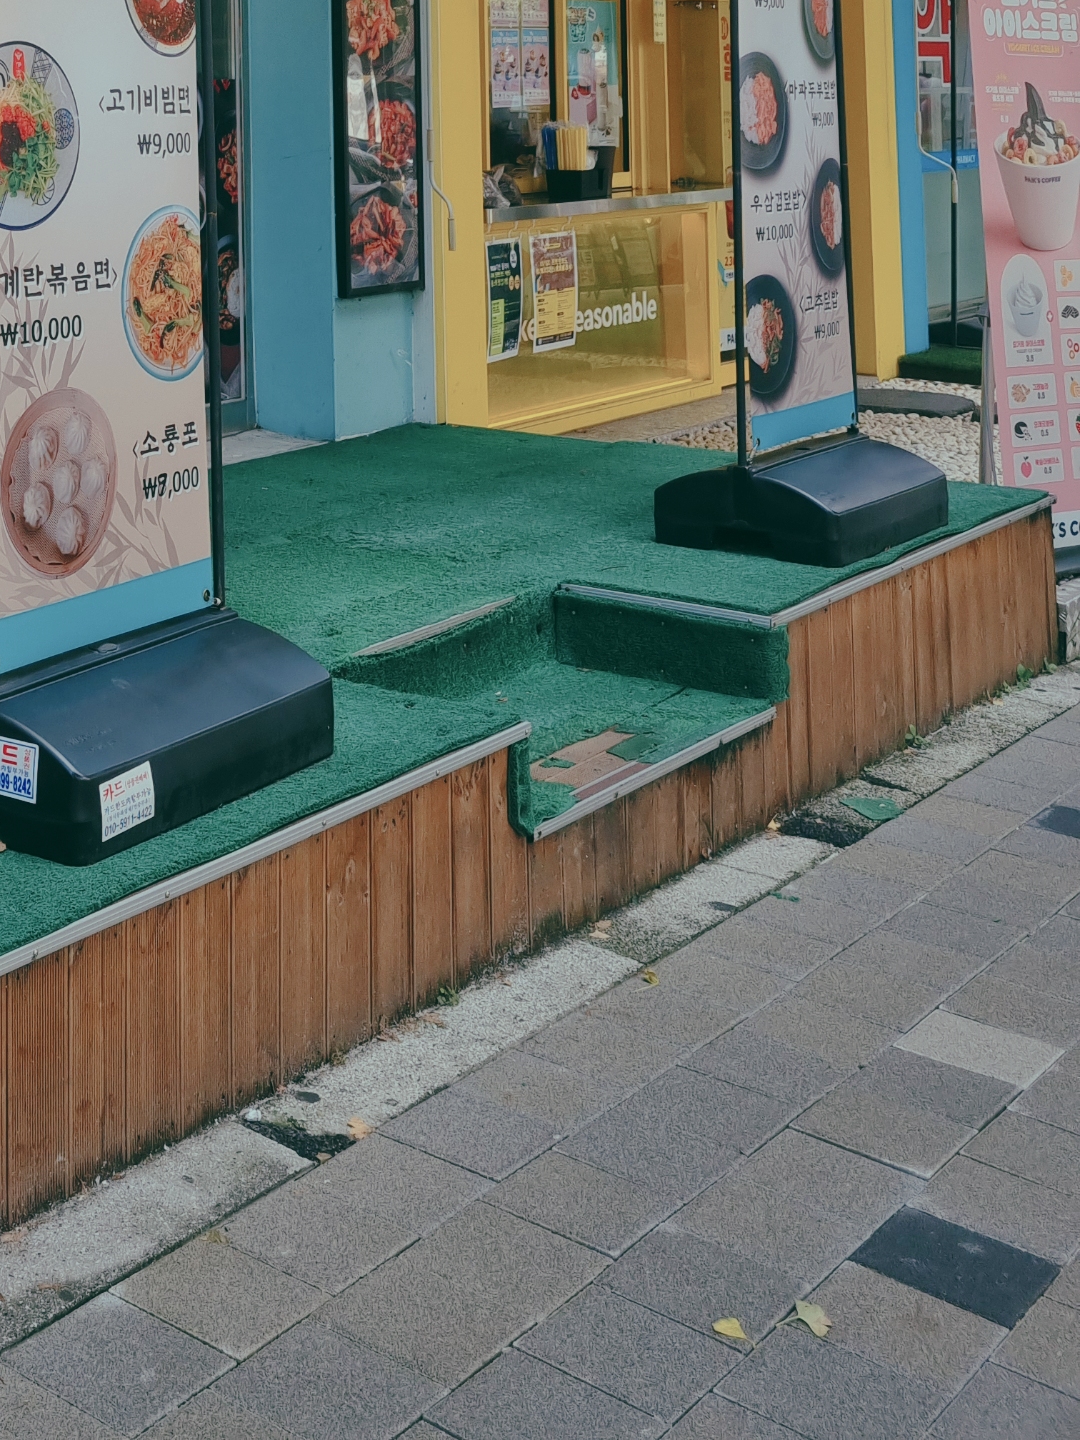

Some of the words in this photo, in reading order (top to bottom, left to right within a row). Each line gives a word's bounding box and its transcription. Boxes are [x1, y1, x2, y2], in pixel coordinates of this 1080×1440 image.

[983, 7, 1079, 42] 아이스크림
[106, 84, 192, 116] 고기비빔면
[788, 79, 836, 100] 마파두부덮밥
[136, 131, 191, 159] ₩9,000
[750, 190, 801, 213] 우삼겹덮밥
[755, 223, 794, 243] ₩10,000
[575, 290, 658, 334] easonable
[804, 288, 839, 312] 고추덮밥
[0, 314, 82, 348] ₩10,000
[139, 421, 199, 459] 소룡포
[102, 781, 126, 802] 카드
